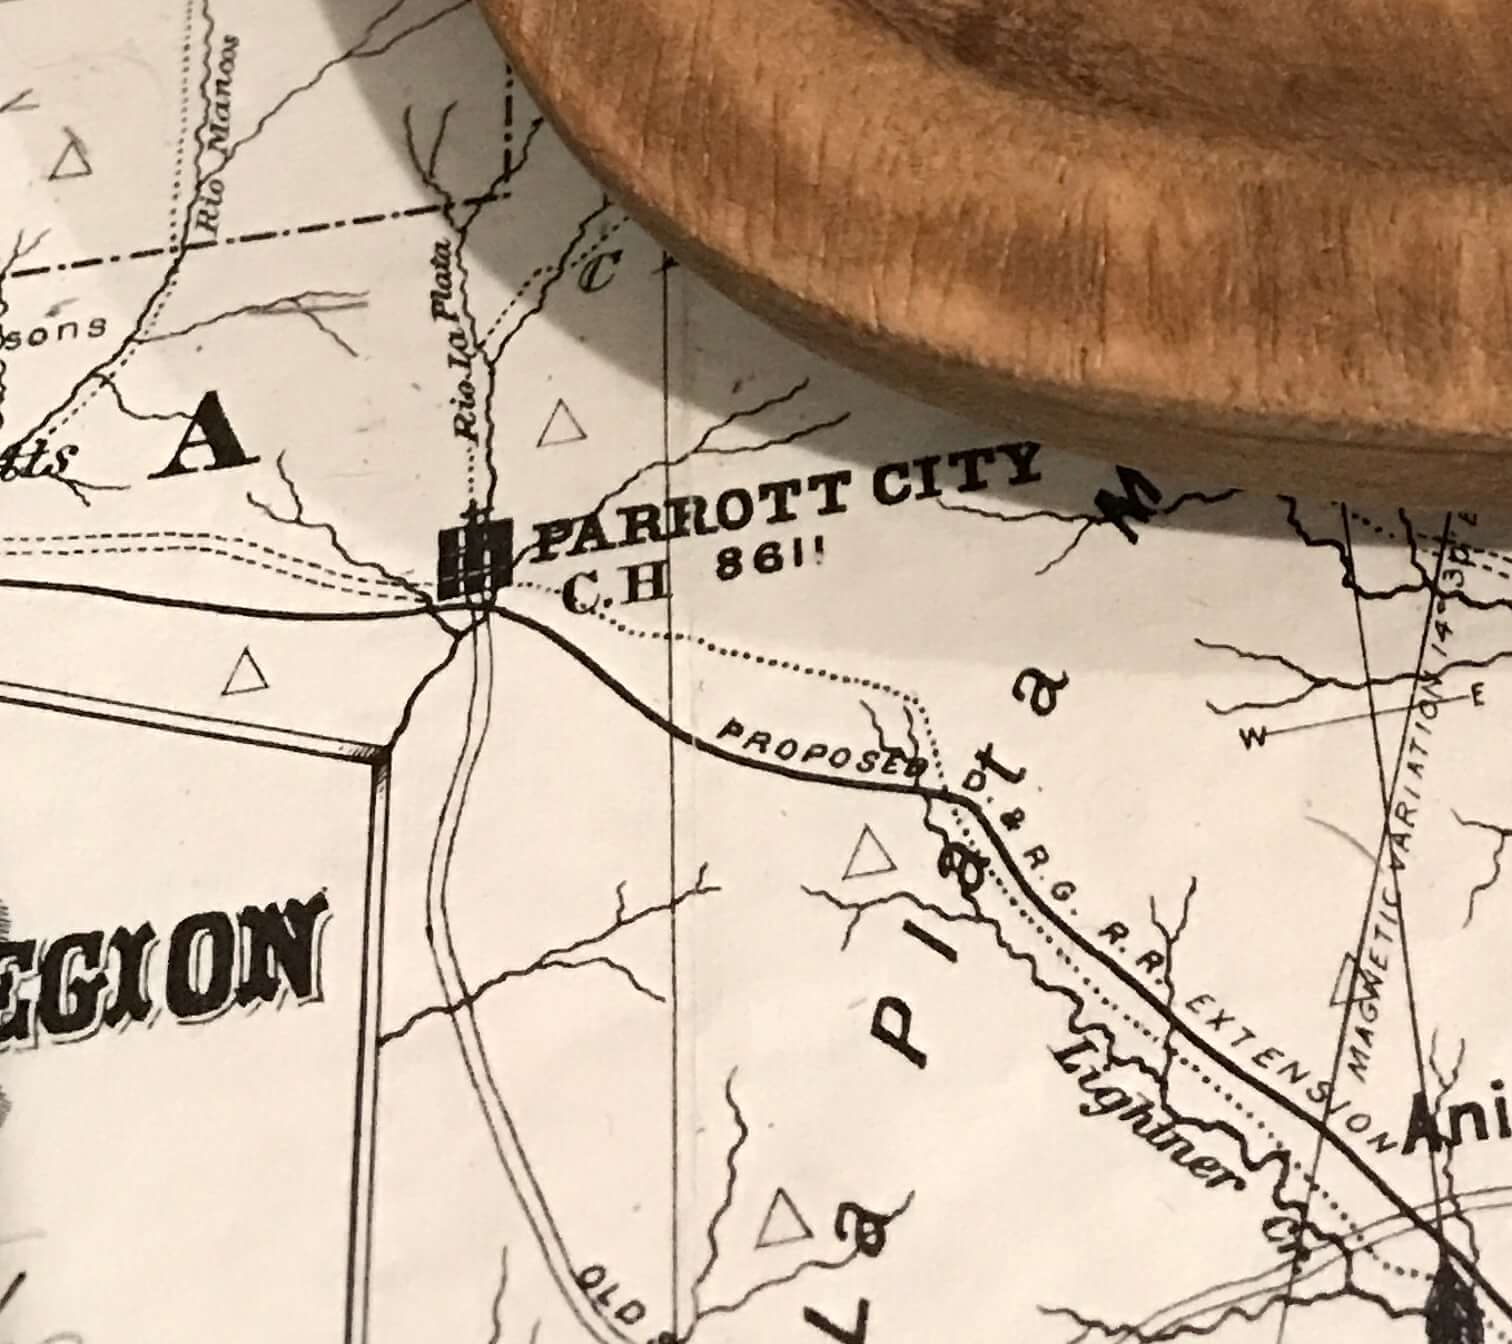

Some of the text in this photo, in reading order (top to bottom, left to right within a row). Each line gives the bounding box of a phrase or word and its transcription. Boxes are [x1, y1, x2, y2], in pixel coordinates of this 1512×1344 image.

[195, 34, 240, 240] Rio Mancos
[430, 236, 460, 323] Plata
[450, 379, 480, 448] Rio
[529, 440, 1042, 564] PARROTT CITY
[1239, 725, 1267, 750] W
[1471, 682, 1485, 707] E
[1347, 886, 1400, 1083] MAGNETIC
[1389, 670, 1442, 872] VARIATION
[716, 717, 929, 777] PROPOSED
[1185, 993, 1398, 1155] EXTENSION
[1047, 1035, 1247, 1192] Lightner
[579, 1264, 647, 1325] OLD
